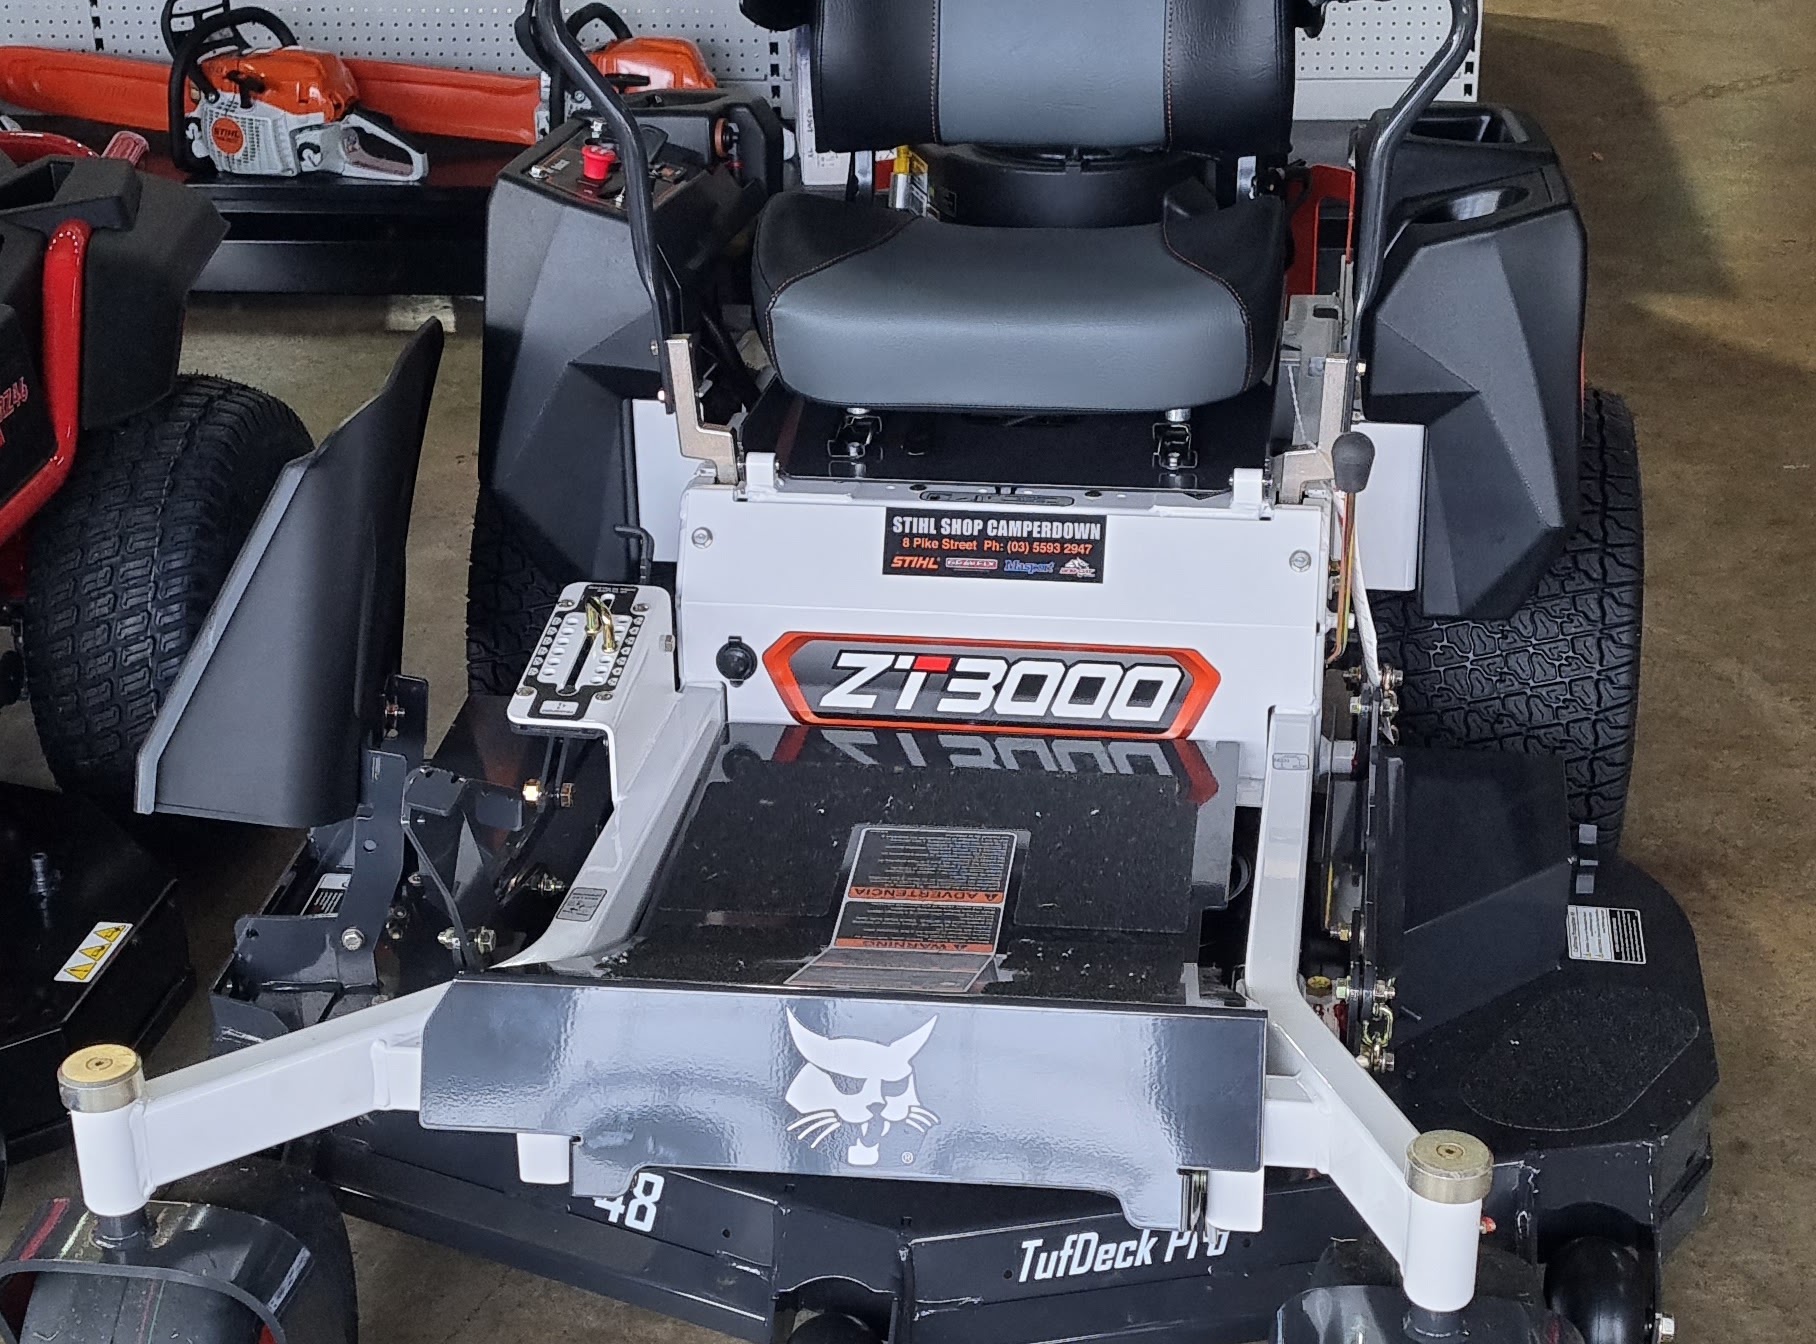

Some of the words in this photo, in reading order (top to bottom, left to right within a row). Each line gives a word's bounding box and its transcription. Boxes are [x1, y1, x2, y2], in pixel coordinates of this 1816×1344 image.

[892, 516, 937, 534] STIHL
[941, 518, 983, 537] SHOP
[987, 520, 1101, 540] CAMPERDOWN
[902, 537, 910, 548] 8
[913, 537, 938, 550] Pike
[942, 538, 977, 551] Street
[984, 541, 1004, 552] Ph:
[1006, 542, 1030, 554] (03)
[1032, 542, 1061, 555] 5593
[1063, 543, 1093, 555] 2947
[891, 556, 938, 570] STIHL
[819, 651, 1180, 723] ZT3000
[854, 887, 978, 901] ADVERTENCIA
[862, 939, 947, 951] WARNING
[1018, 1228, 1158, 1283] TufDeck
